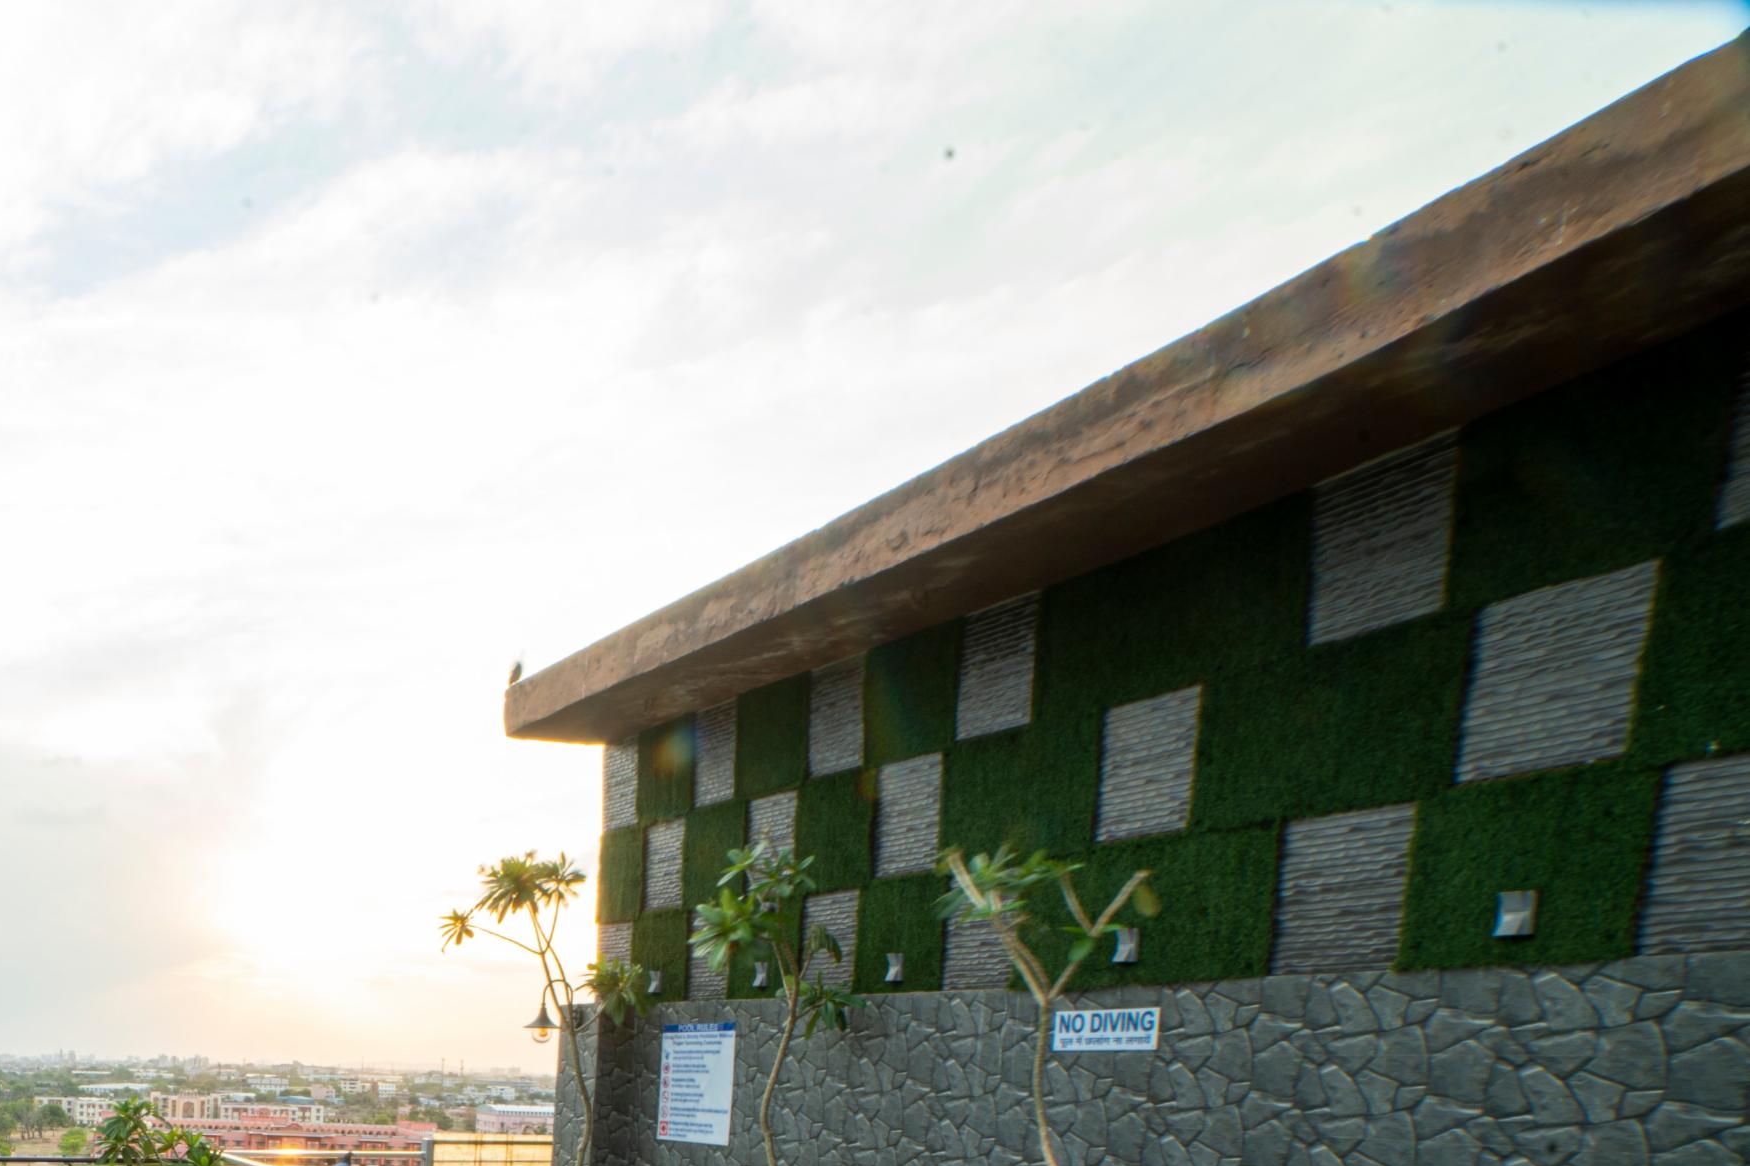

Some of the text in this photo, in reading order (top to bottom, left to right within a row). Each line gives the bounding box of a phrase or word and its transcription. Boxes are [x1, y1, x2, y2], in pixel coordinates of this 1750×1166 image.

[678, 1024, 695, 1032] POOL
[1059, 1011, 1154, 1033] NO DIVING
